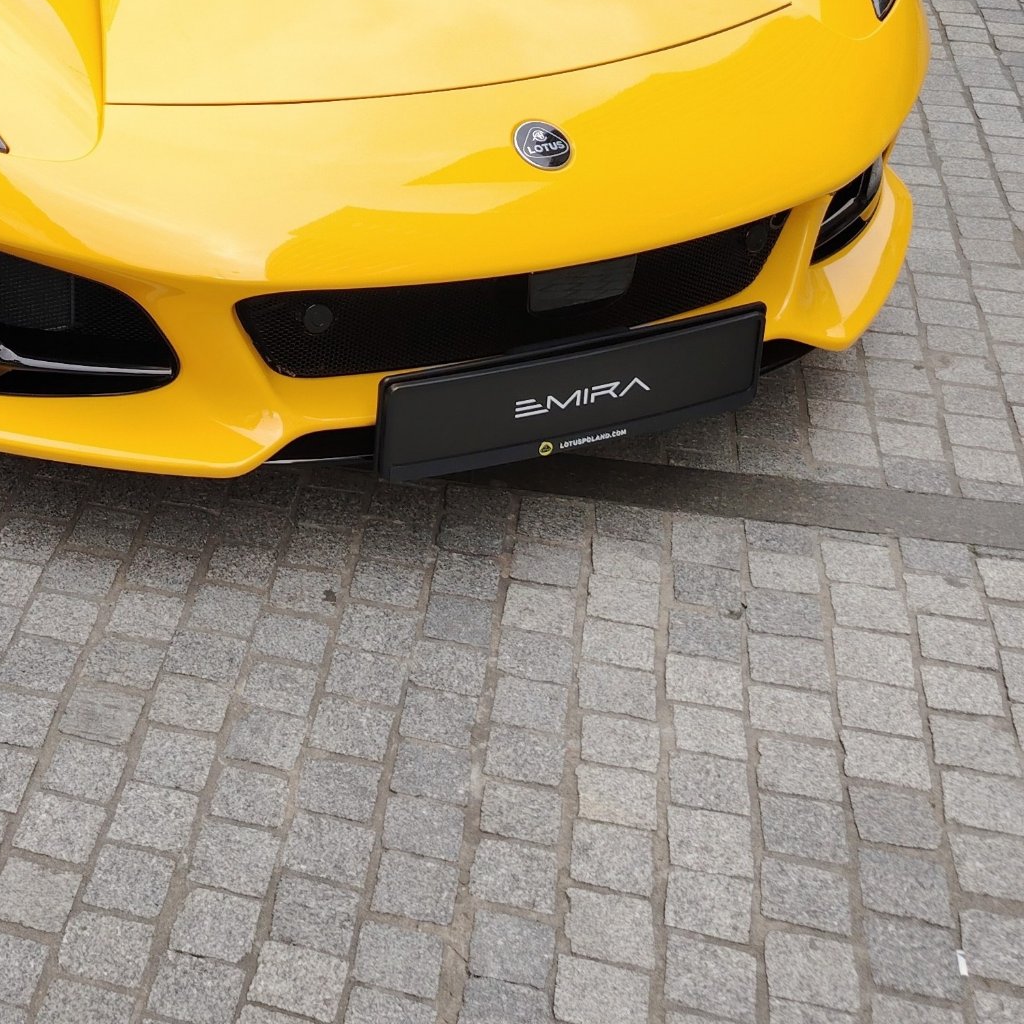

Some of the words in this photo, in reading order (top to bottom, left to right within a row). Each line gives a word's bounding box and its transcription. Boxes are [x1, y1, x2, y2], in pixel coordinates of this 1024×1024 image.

[527, 140, 565, 154] LOTUS
[514, 377, 651, 419] EMIRA
[559, 428, 627, 449] LOTUSPOLAND.COM
